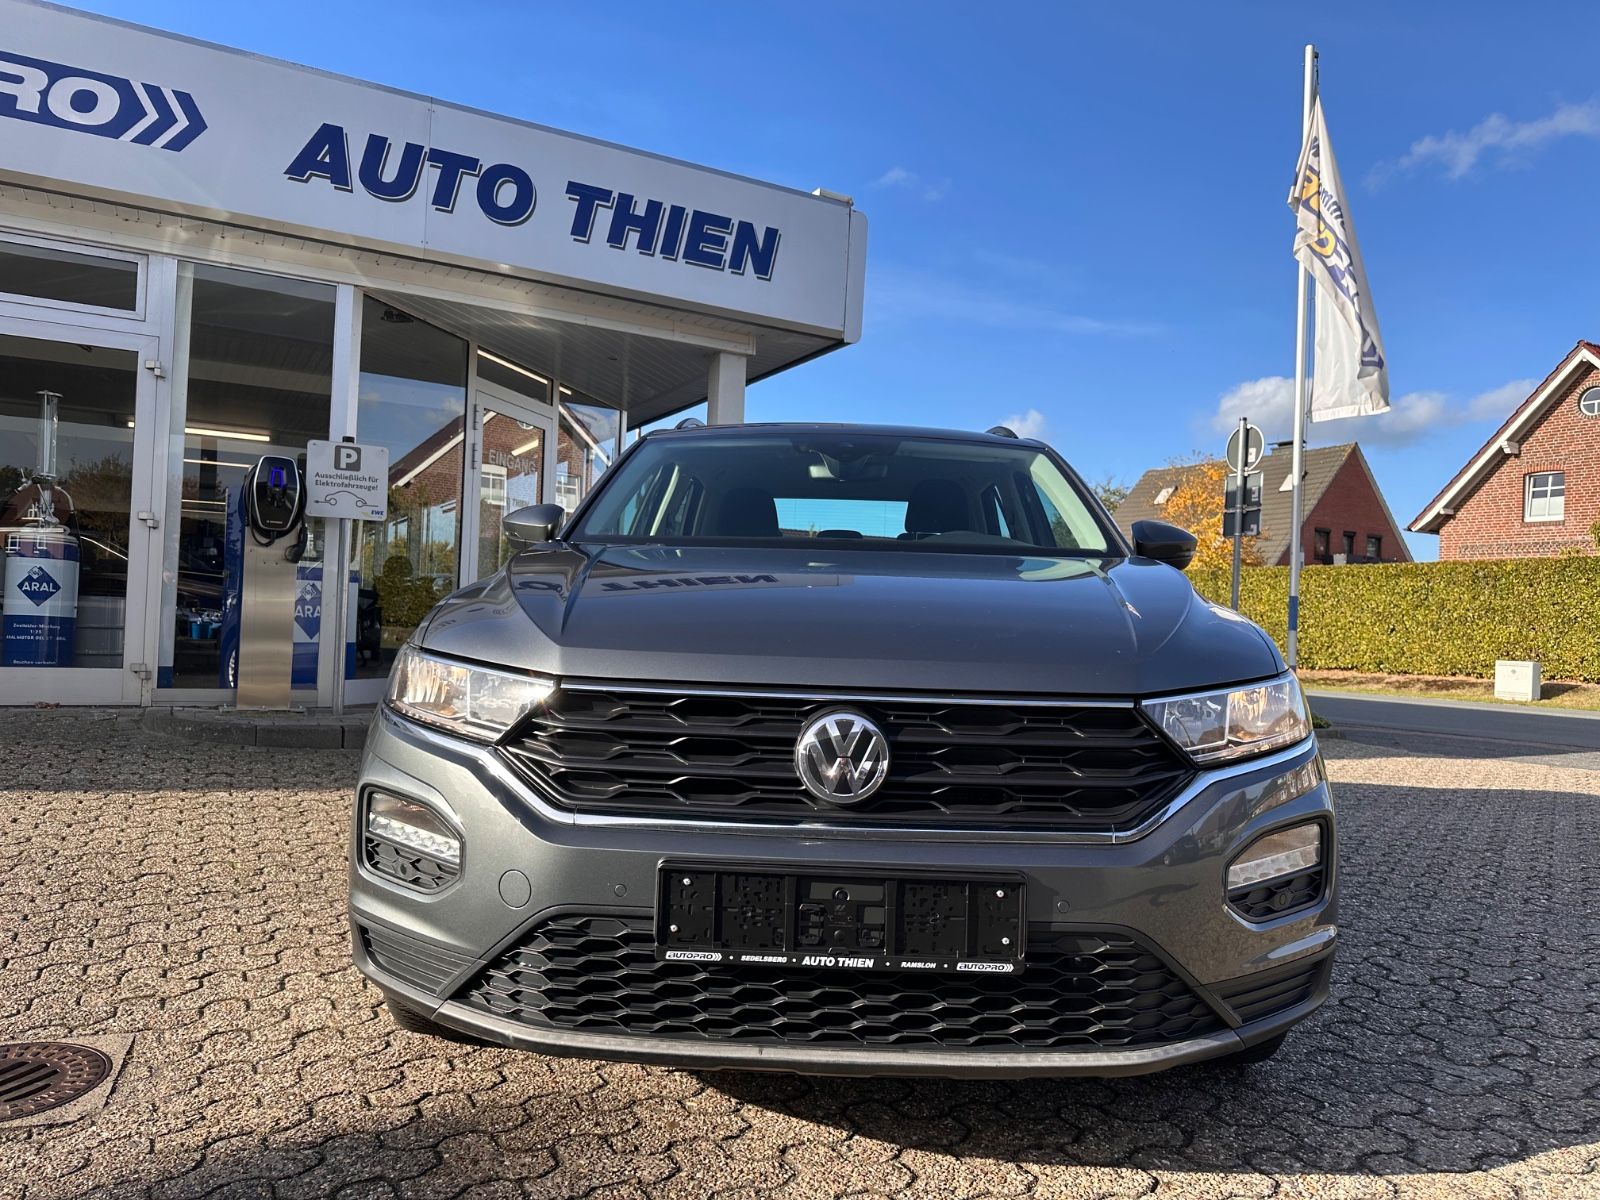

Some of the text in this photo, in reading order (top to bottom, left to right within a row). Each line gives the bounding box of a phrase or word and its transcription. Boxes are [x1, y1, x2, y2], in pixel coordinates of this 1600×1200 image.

[283, 123, 780, 281] AUTO THIEN
[340, 448, 358, 469] P
[489, 449, 537, 473] EINGANG
[315, 472, 367, 482] Ausschließlich
[315, 479, 379, 491] Elektrofahrzeuge!
[22, 581, 57, 592] ARAL
[295, 604, 321, 618] ARA
[741, 955, 788, 963] SEDELSBERG
[802, 956, 836, 967] AUTO
[838, 957, 874, 968] THIEN
[901, 961, 937, 969] RAMSLOH
